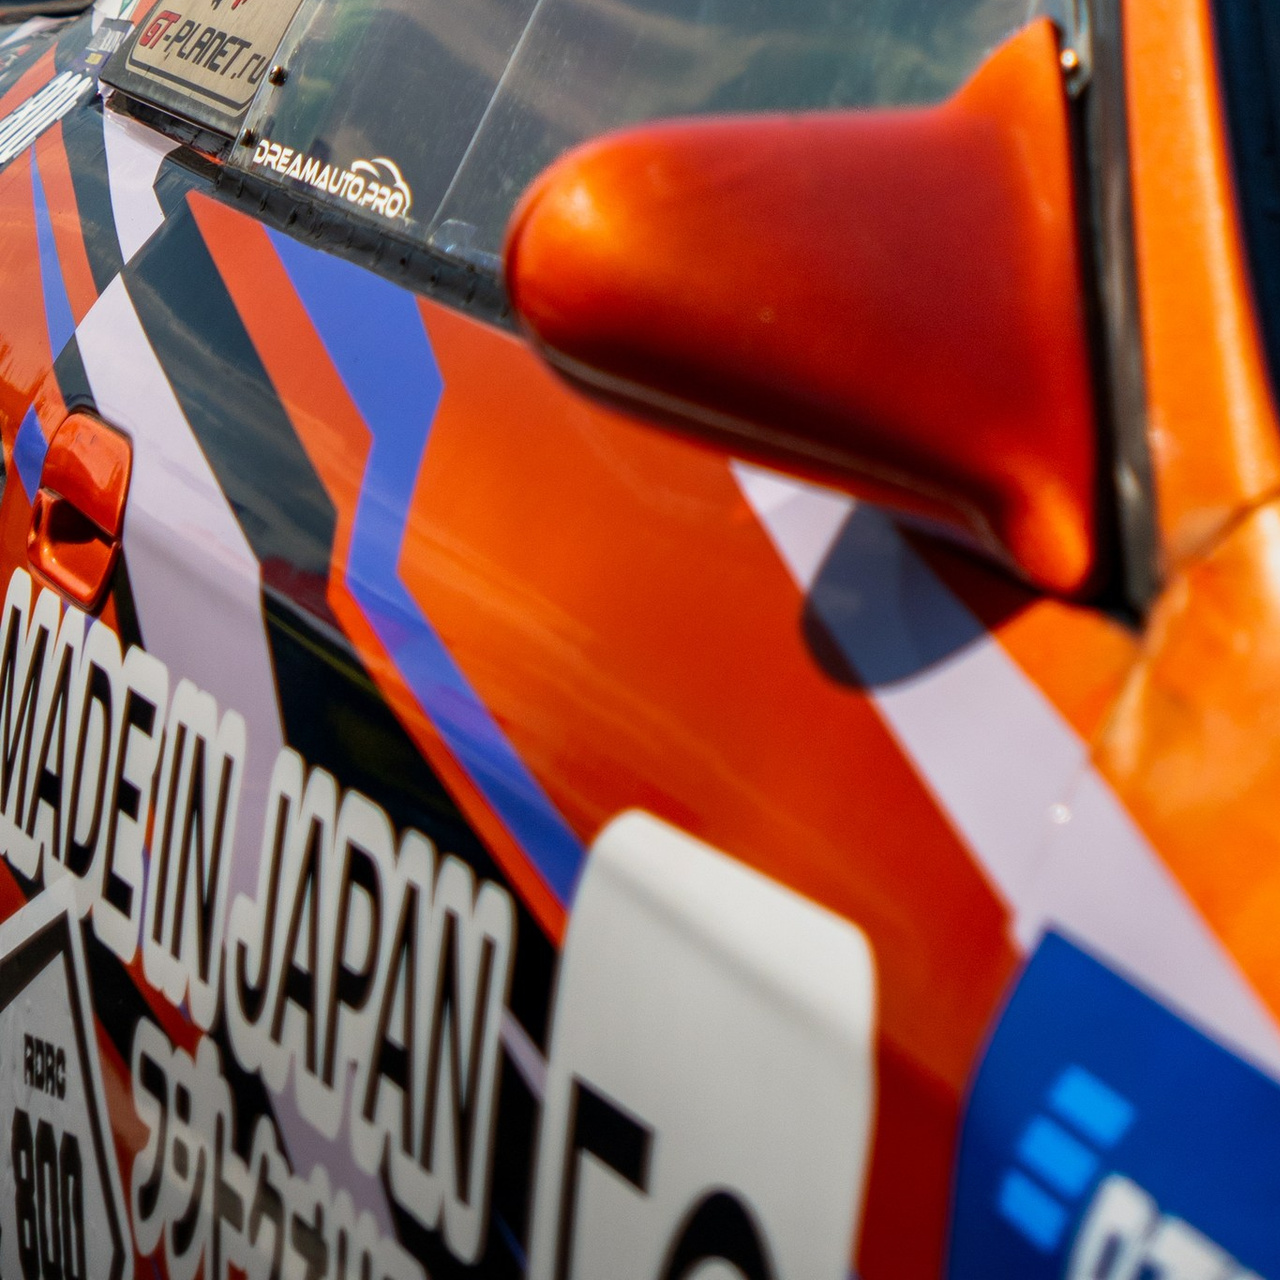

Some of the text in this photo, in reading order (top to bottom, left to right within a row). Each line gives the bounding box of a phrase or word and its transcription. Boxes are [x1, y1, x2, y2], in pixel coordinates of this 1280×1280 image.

[138, 9, 271, 85] GT-PLANET.ru
[252, 139, 404, 219] DREAMAUTO.PRO
[0, 598, 160, 928] MADE
[149, 712, 238, 998] IN
[233, 782, 502, 1218] JAPAN
[24, 1033, 67, 1102] RDRC
[11, 1106, 87, 1280] 800
